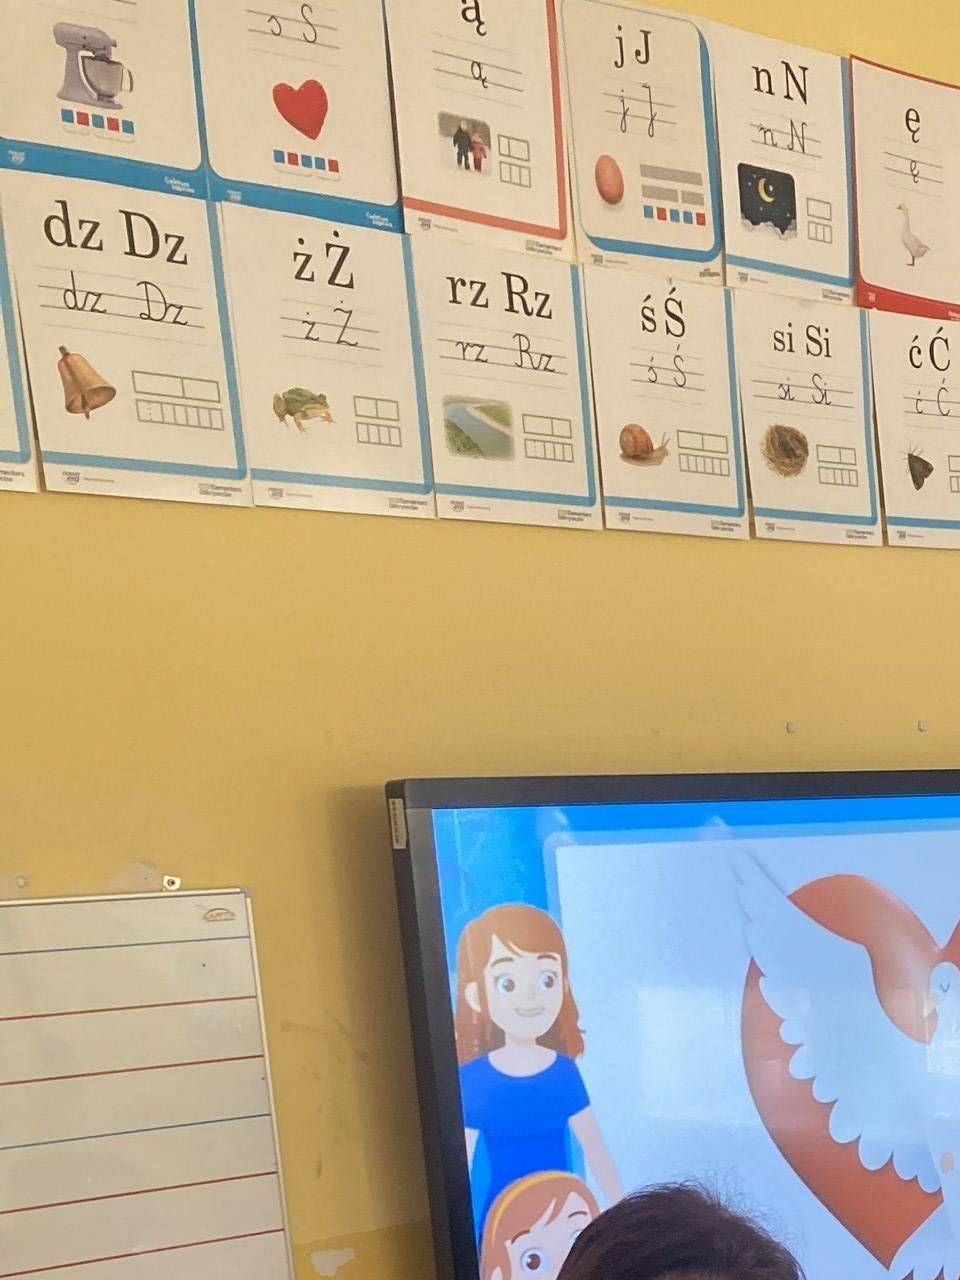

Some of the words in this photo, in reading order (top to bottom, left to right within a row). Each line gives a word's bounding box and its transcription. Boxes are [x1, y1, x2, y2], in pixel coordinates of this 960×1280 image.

[905, 108, 921, 144] ę
[44, 199, 104, 254] dz
[118, 209, 189, 266] Dz
[63, 269, 107, 314] dz
[136, 280, 188, 326] Dz
[445, 276, 489, 309] rz
[500, 271, 553, 320] Rz
[455, 341, 489, 364] rz
[512, 332, 556, 373] Rz
[773, 322, 796, 353] si
[805, 324, 832, 358] Si
